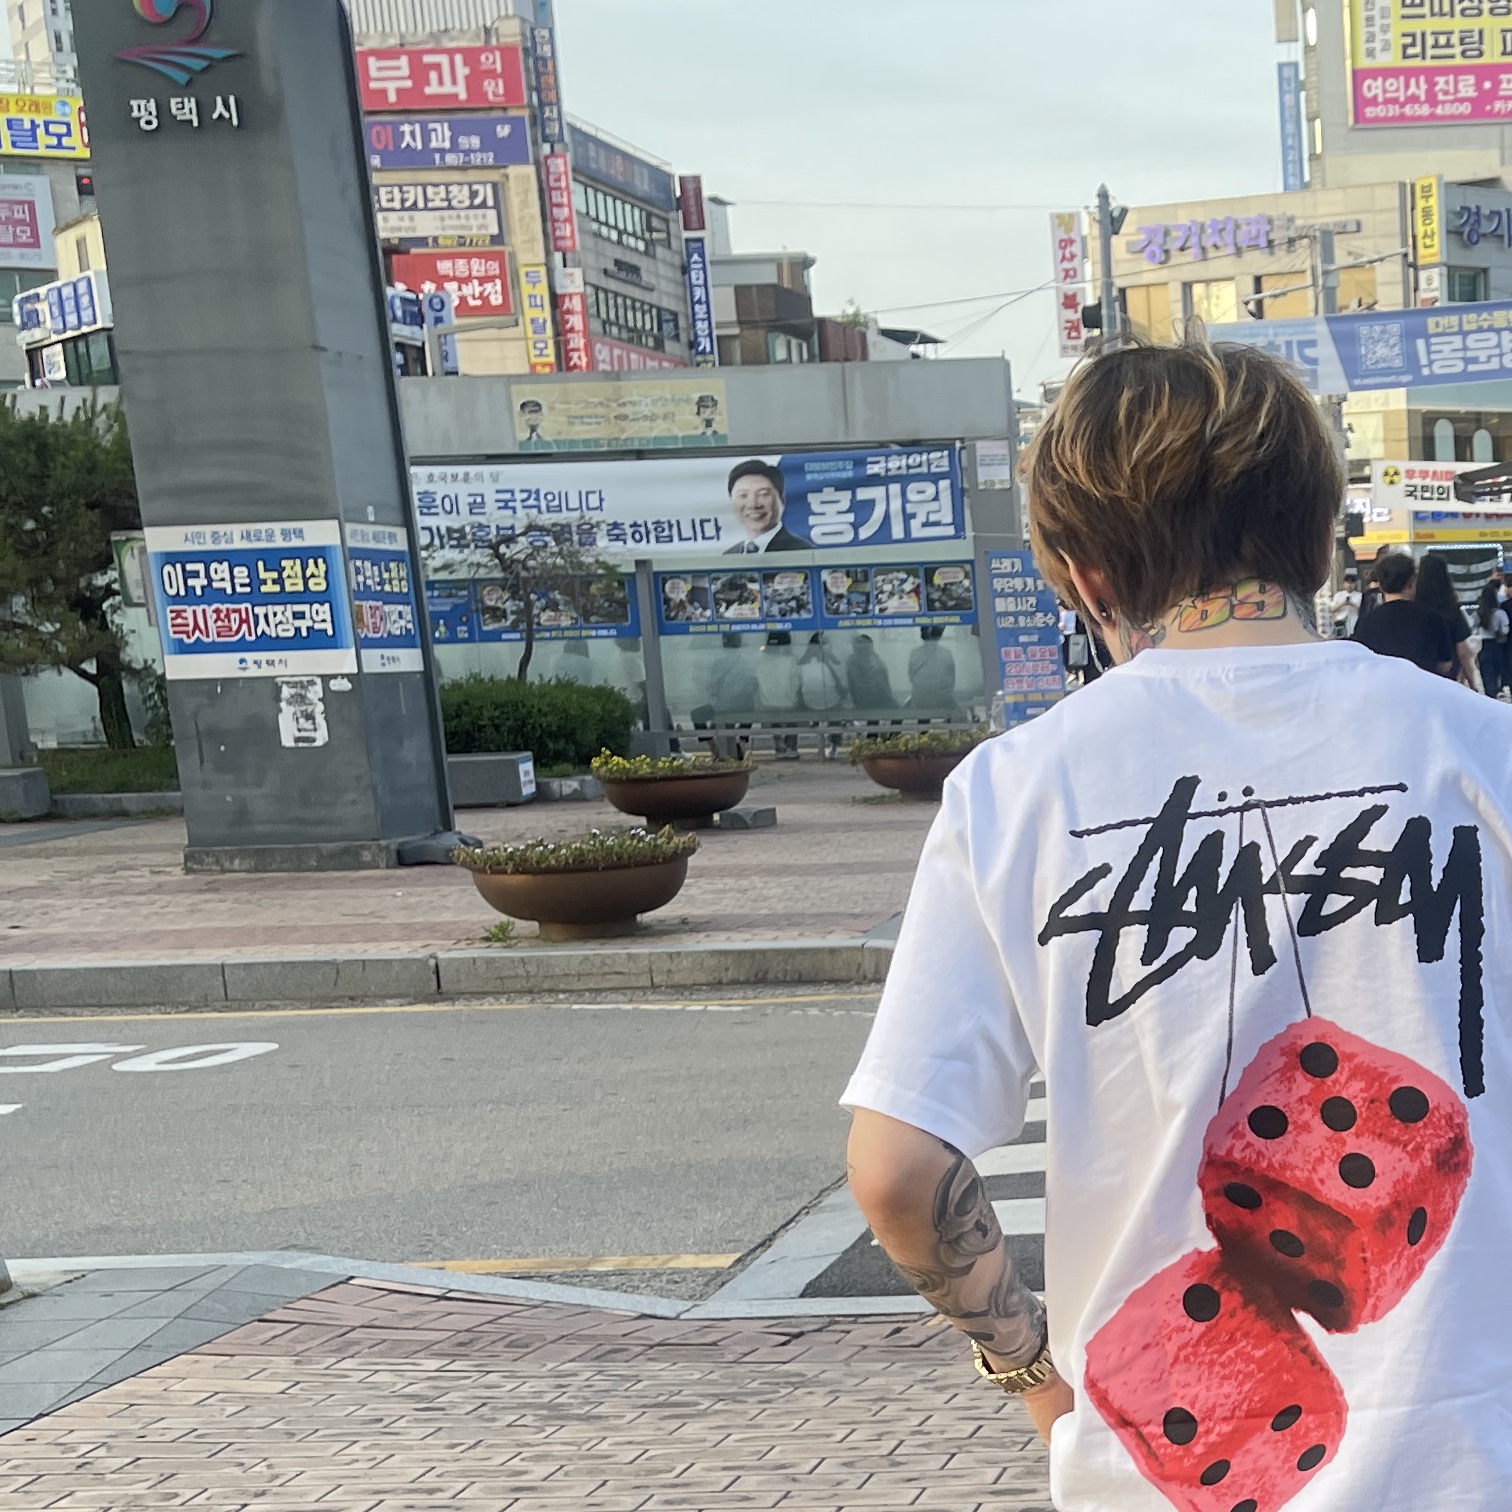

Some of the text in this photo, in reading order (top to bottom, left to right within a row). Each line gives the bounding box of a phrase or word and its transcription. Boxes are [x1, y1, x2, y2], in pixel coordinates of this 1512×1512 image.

[1400, 27, 1485, 61] 리프팅
[1361, 75, 1428, 103] 여의사
[1433, 74, 1479, 102] 진료
[128, 95, 240, 132] 평택시
[5, 117, 77, 151] 탈모
[374, 182, 495, 211] 타키보청기
[1419, 180, 1437, 250] 부동산
[1136, 212, 1271, 266] 경기치과
[436, 257, 501, 278] 백종원의
[524, 269, 551, 359] 두피탈모
[1061, 291, 1083, 341] 복권
[561, 295, 589, 373] 세계과자
[866, 449, 950, 477] 국회의원
[466, 492, 488, 515] 곧
[494, 487, 606, 515] 국격입니다
[1404, 483, 1451, 501] 국민의
[806, 478, 956, 546] 홍기원
[239, 528, 278, 544] 새로운
[605, 516, 722, 545] 축하합니다
[162, 556, 328, 598] 이구역은 노점상
[990, 557, 1023, 574] 쓰레기
[254, 601, 333, 638] 지정구역
